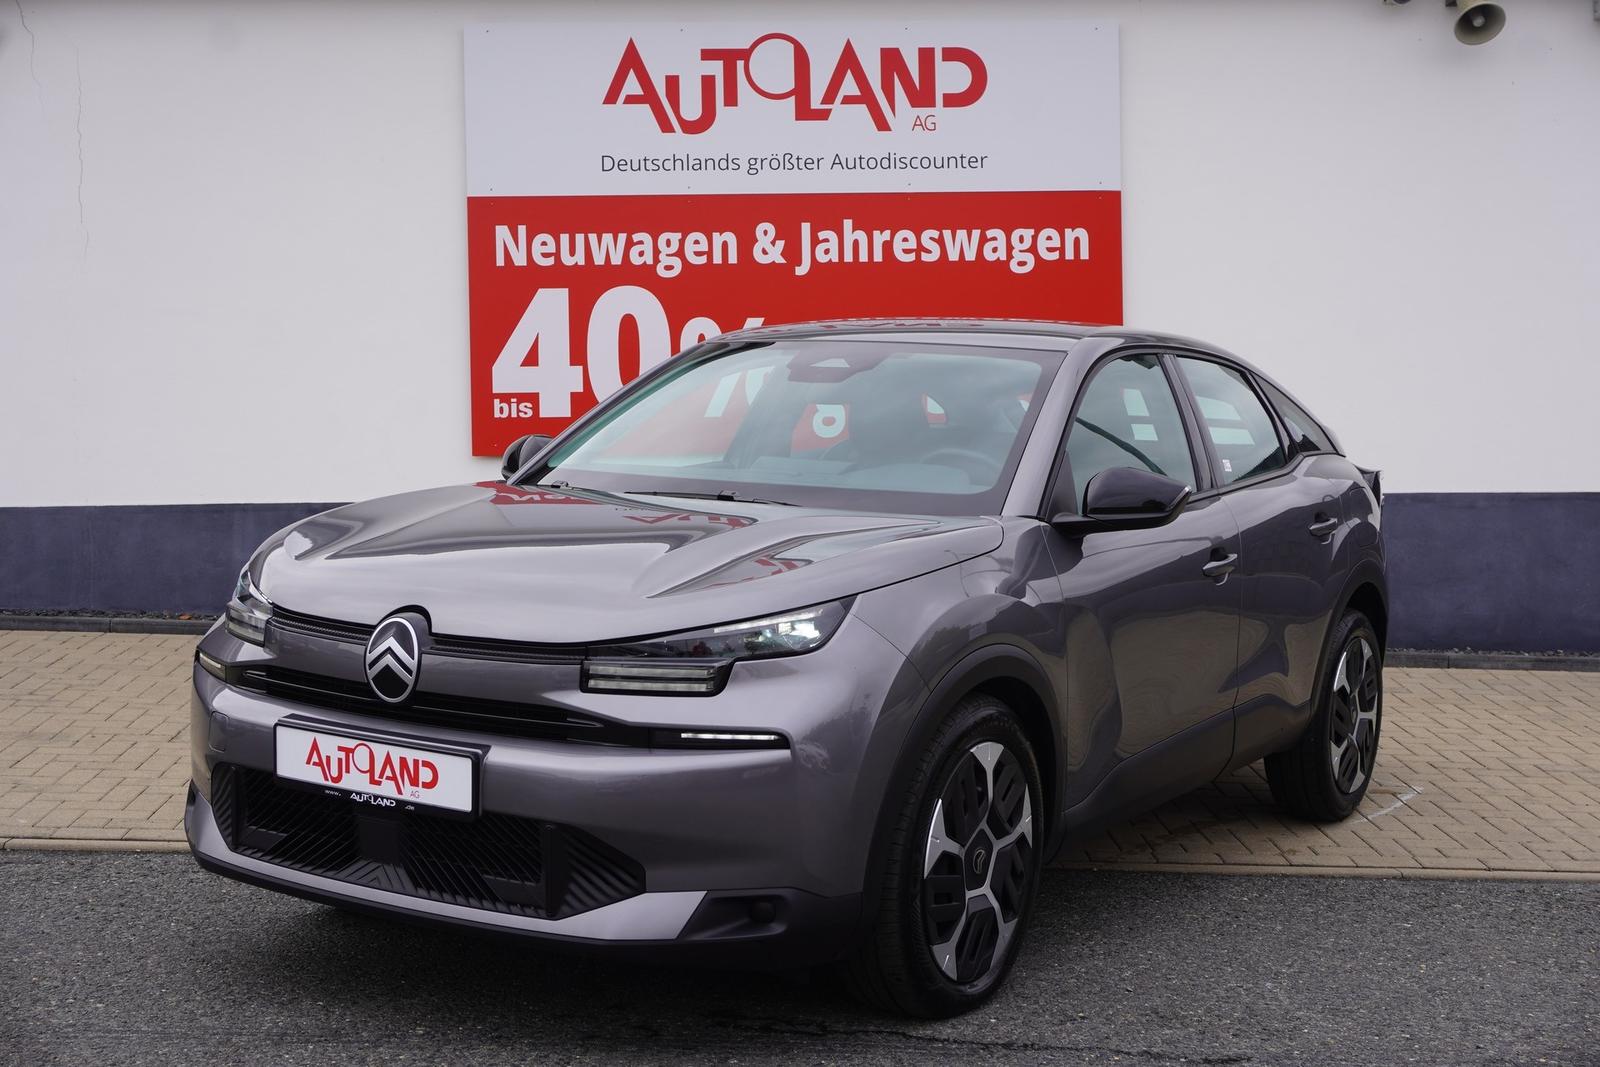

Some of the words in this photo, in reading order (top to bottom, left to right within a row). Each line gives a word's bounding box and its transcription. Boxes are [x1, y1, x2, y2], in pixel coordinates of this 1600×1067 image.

[602, 32, 989, 136] AUTOLAND
[912, 115, 937, 132] AG
[600, 152, 741, 173] Deutschlands
[746, 152, 825, 176] größter
[830, 151, 988, 171] Autodiscounter
[495, 223, 738, 278] Neuwagen
[752, 222, 787, 265] &
[794, 218, 1090, 276] Jahreswagen
[493, 398, 533, 418] bis
[305, 736, 439, 796] AUTOLAND
[350, 792, 396, 807] AUTOLAND
[409, 790, 421, 799] AG
